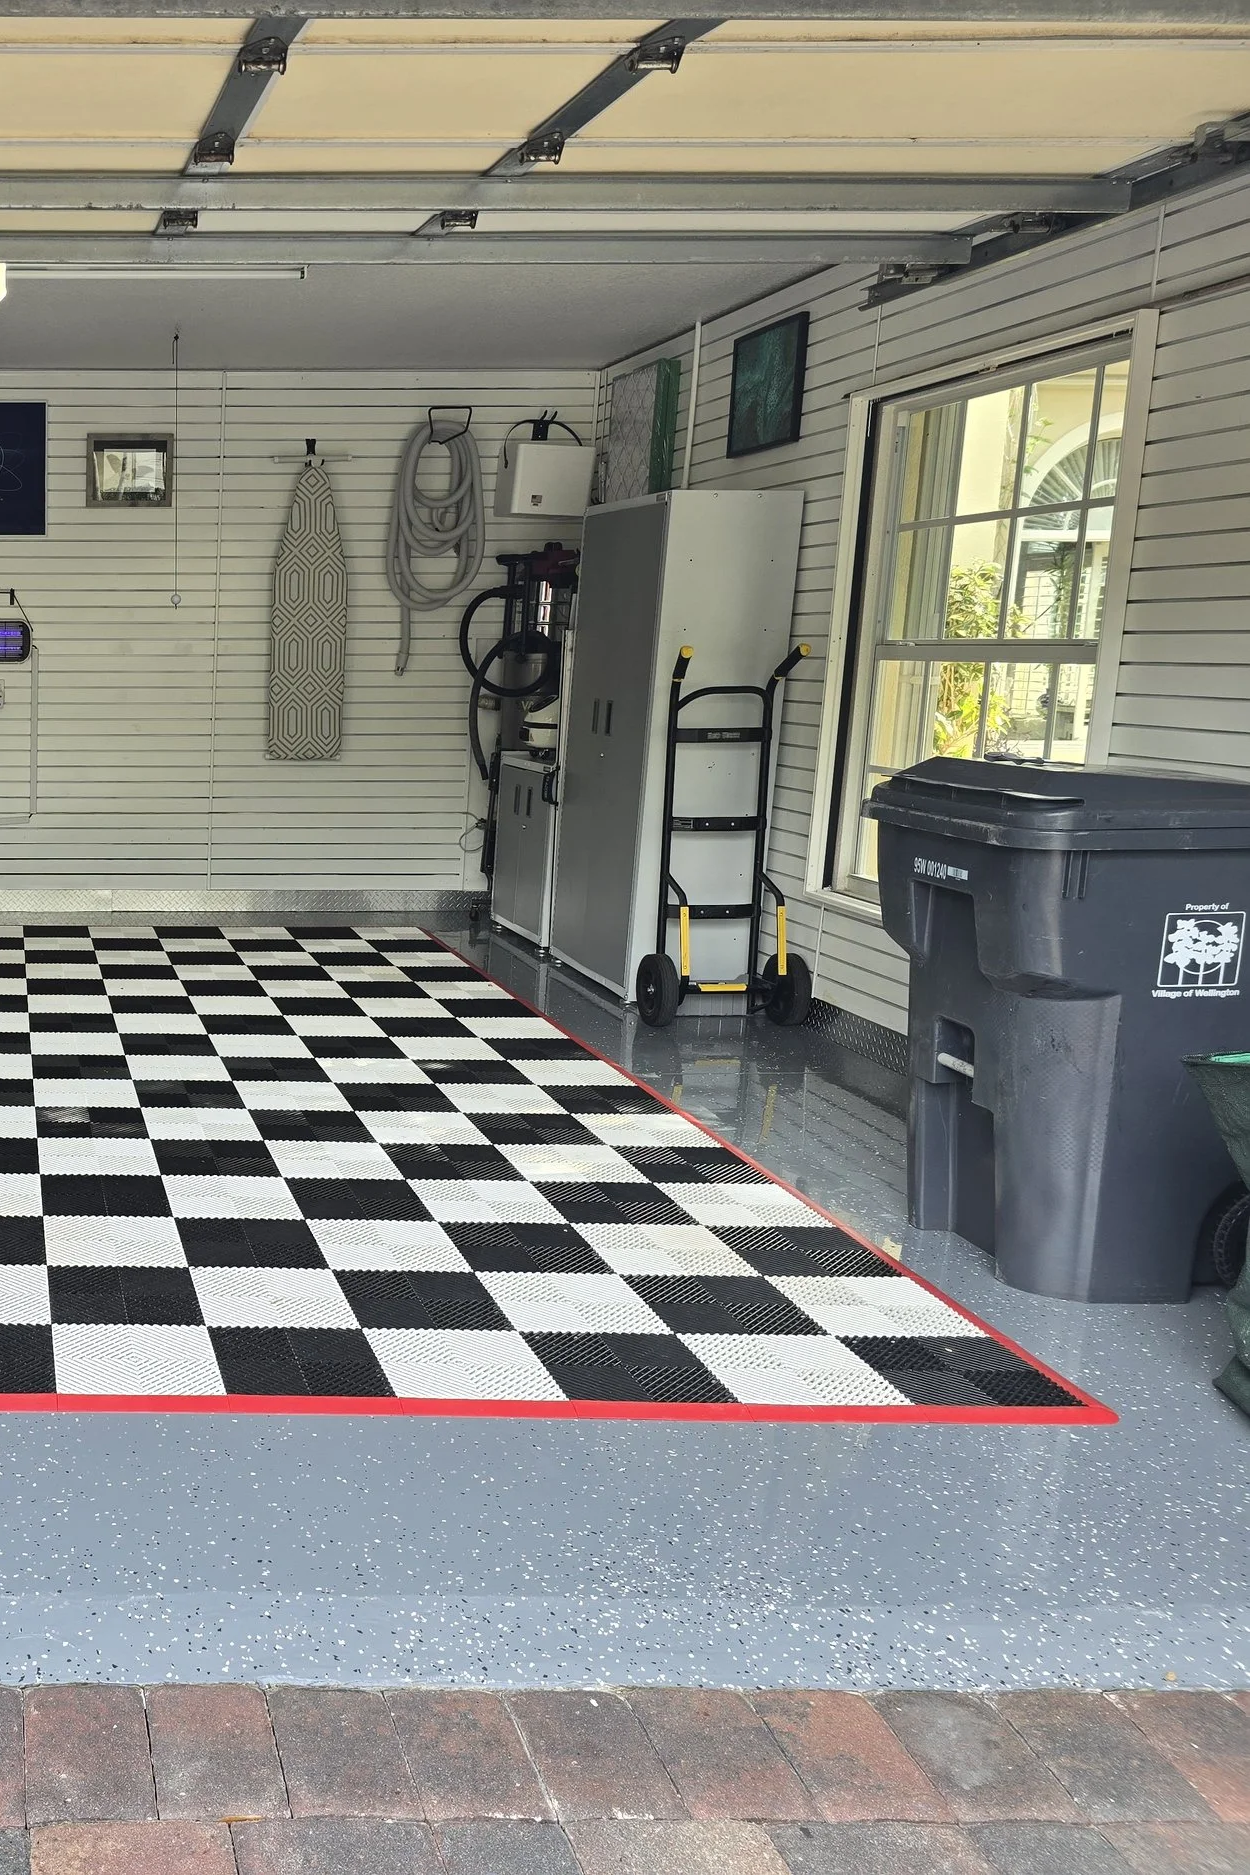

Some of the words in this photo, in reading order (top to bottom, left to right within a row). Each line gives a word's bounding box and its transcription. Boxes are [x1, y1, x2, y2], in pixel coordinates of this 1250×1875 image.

[913, 857, 927, 875] 95W
[927, 860, 947, 880] 001240
[1185, 903, 1219, 912] Property
[1220, 902, 1230, 910] of
[1151, 989, 1182, 999] Village
[1183, 989, 1193, 997] of
[1194, 988, 1240, 998] Wellington
